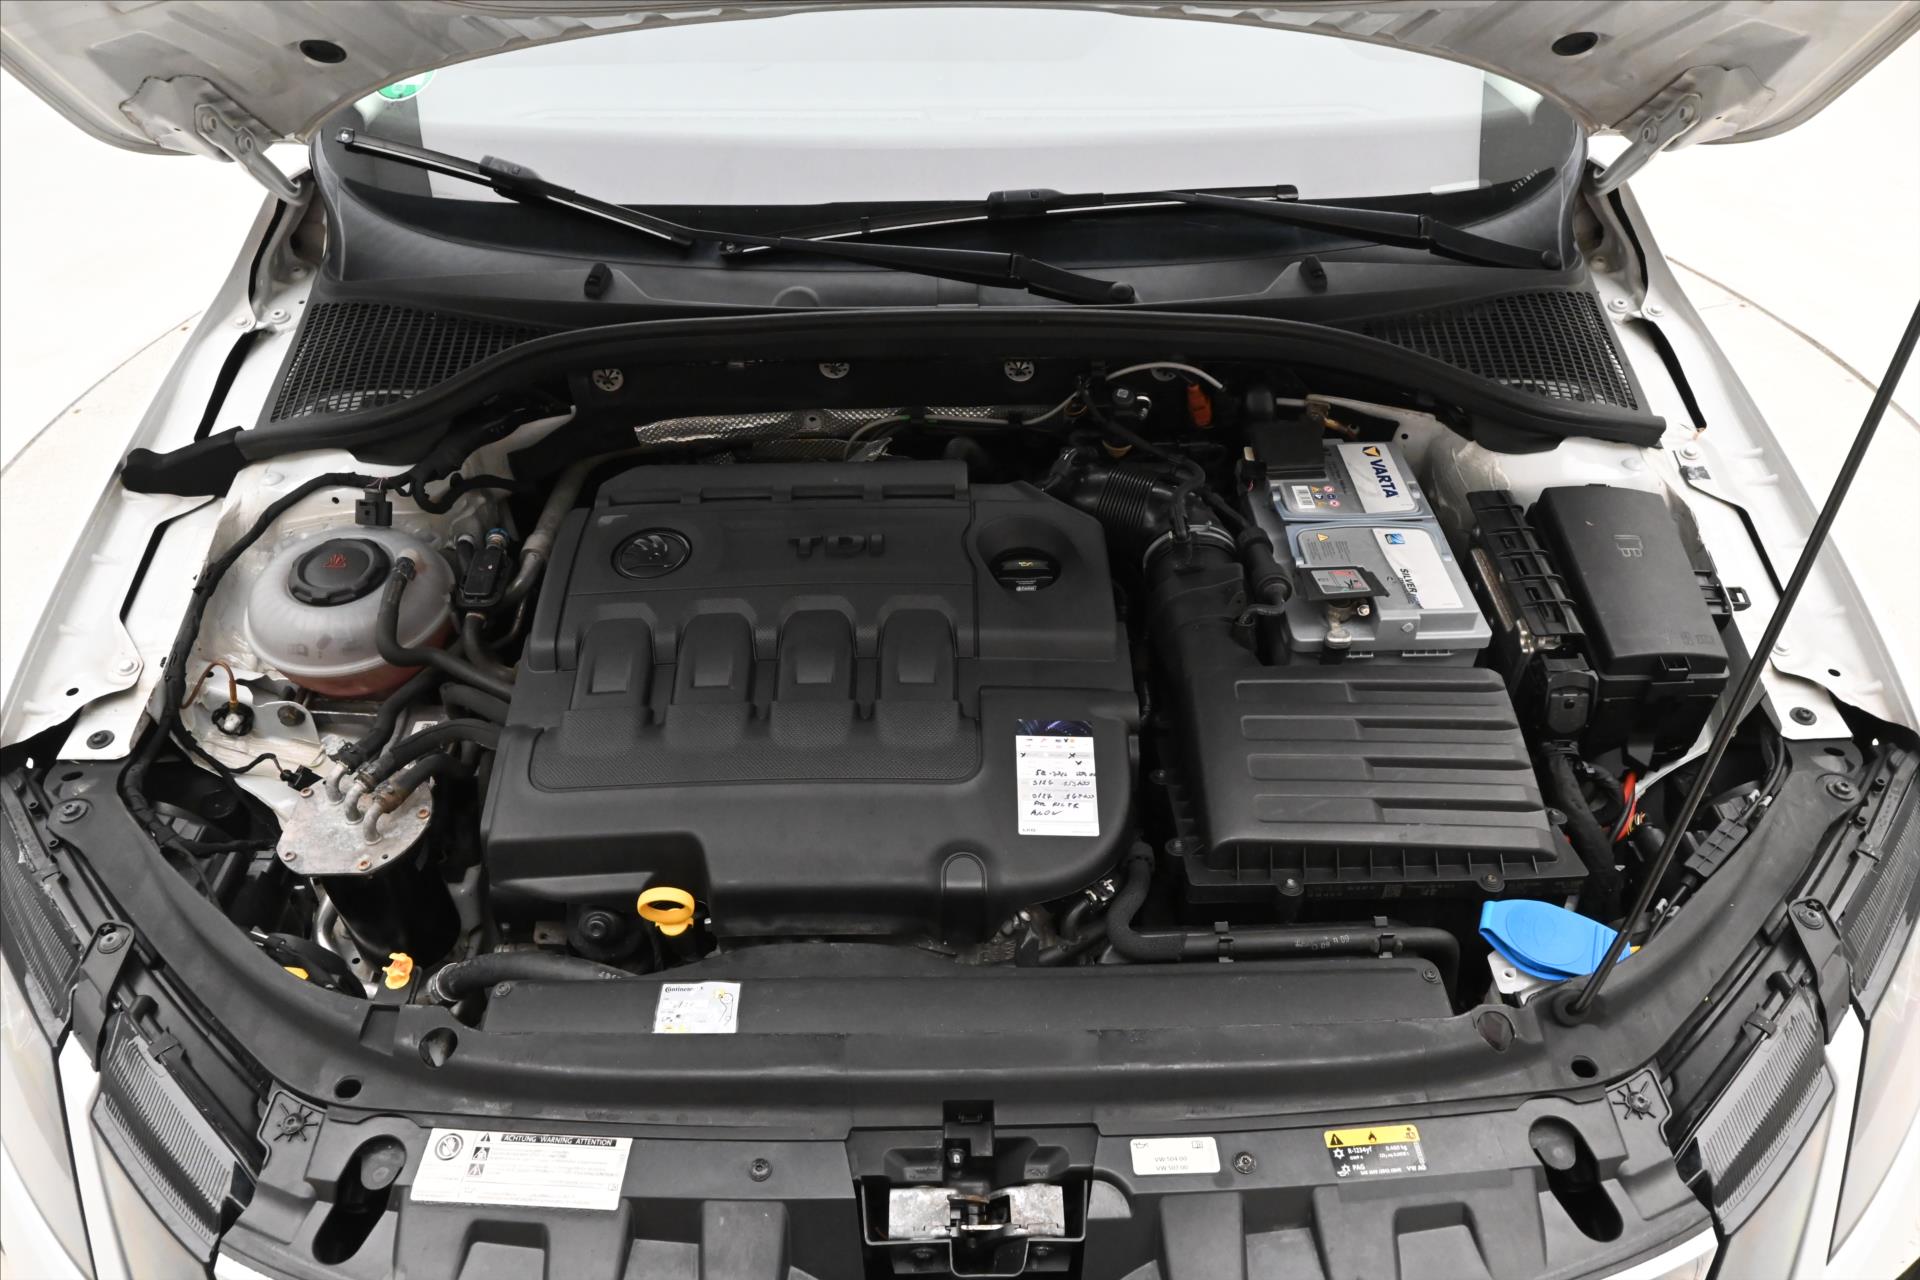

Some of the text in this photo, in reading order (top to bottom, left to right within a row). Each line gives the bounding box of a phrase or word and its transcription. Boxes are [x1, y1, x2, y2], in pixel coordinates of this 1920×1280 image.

[1369, 458, 1399, 499] VARTA
[787, 533, 886, 560] TDI
[1399, 567, 1418, 593] SILVER
[503, 1134, 612, 1147] ACHTUNG WARNING ATTENTION
